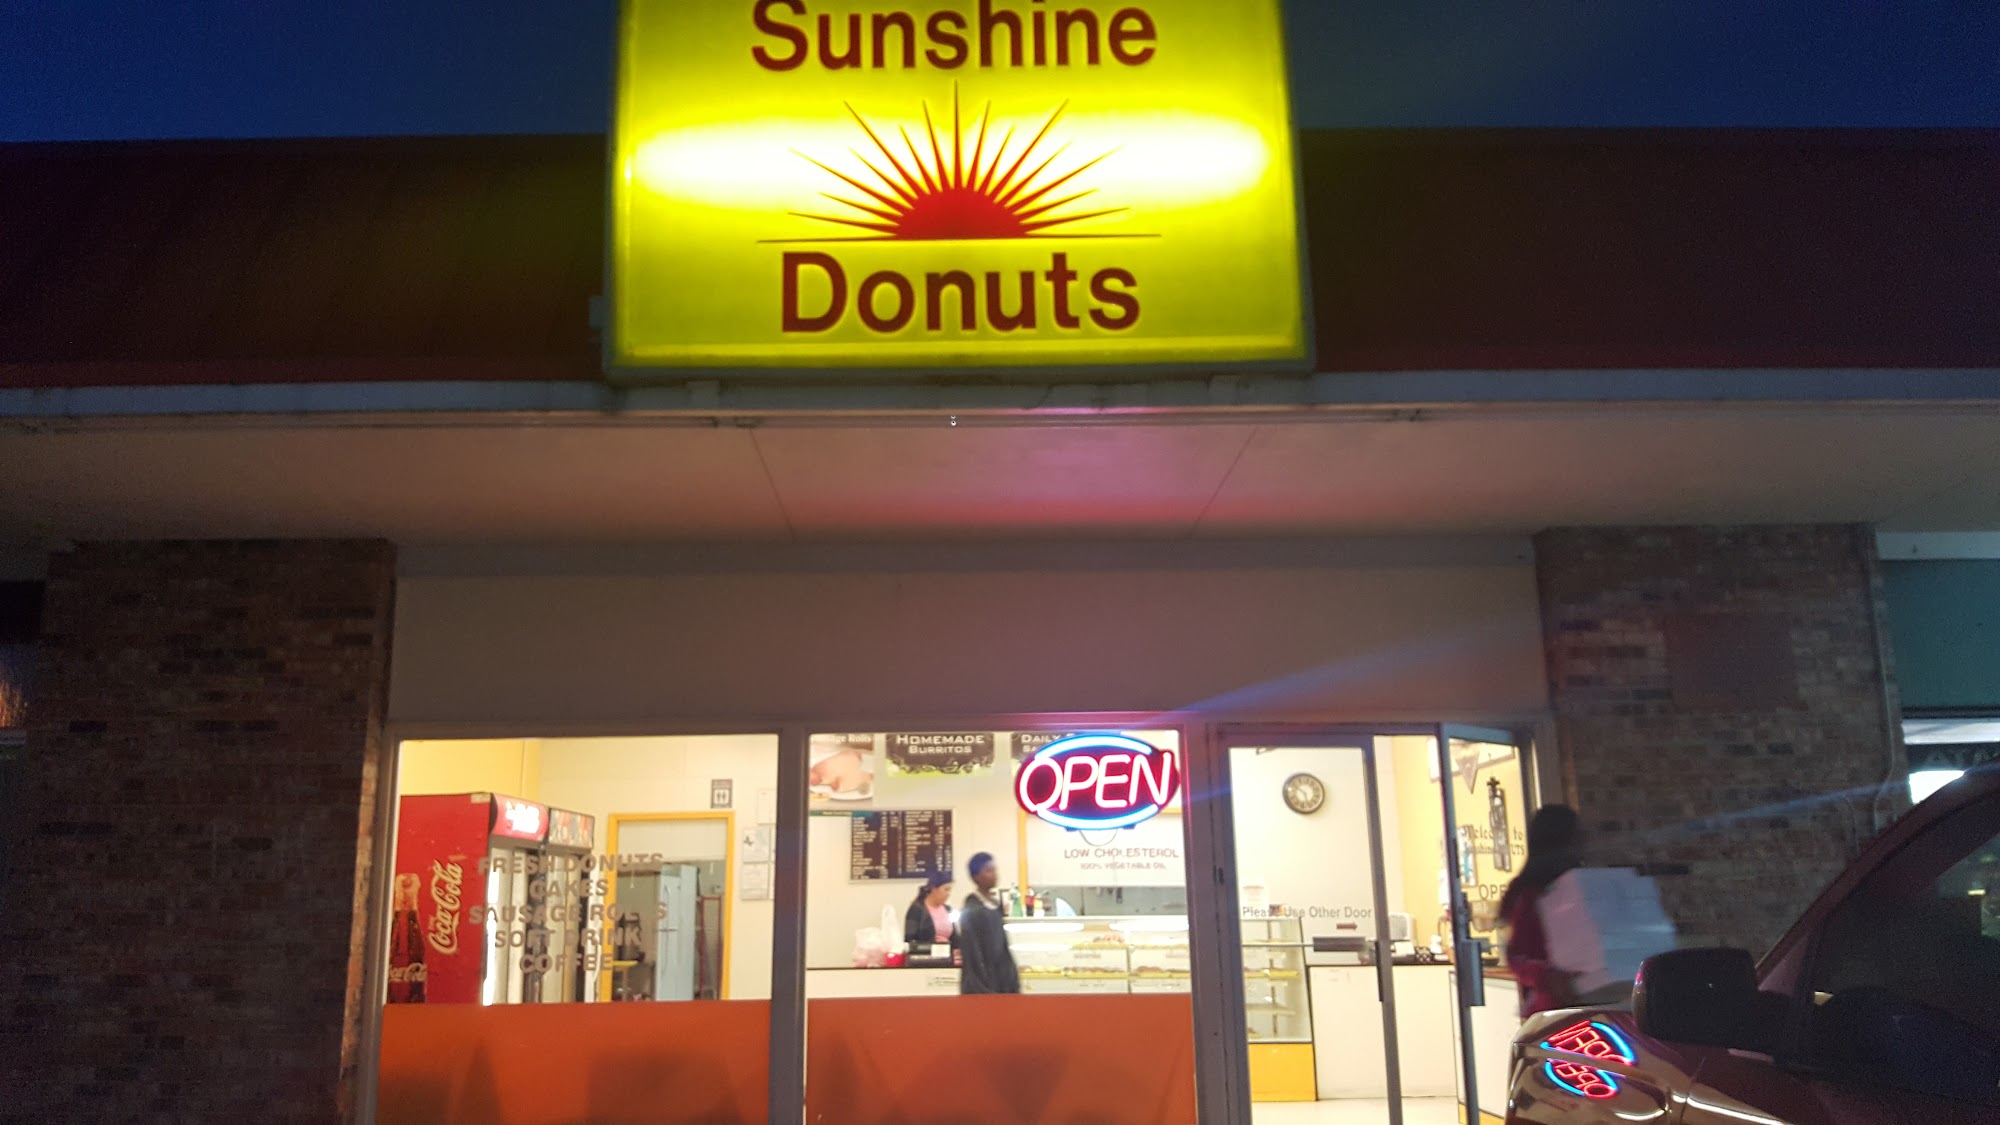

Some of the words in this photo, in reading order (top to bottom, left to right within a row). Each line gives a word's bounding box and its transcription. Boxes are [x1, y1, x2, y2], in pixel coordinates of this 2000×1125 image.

[751, 0, 1157, 71] Sunshine
[781, 251, 1141, 334] Donuts
[1019, 751, 1173, 812] OPEN
[1064, 848, 1090, 859] LOW
[1094, 847, 1179, 858] CHOLESTEROL
[477, 855, 554, 875] FRESH
[528, 878, 609, 898] CAKES
[468, 903, 584, 925] SAUSAGE
[590, 902, 668, 922] ROS
[1284, 906, 1306, 918] Use
[1308, 905, 1341, 918] Other
[1344, 906, 1373, 918] Door
[494, 928, 555, 948] SOFT
